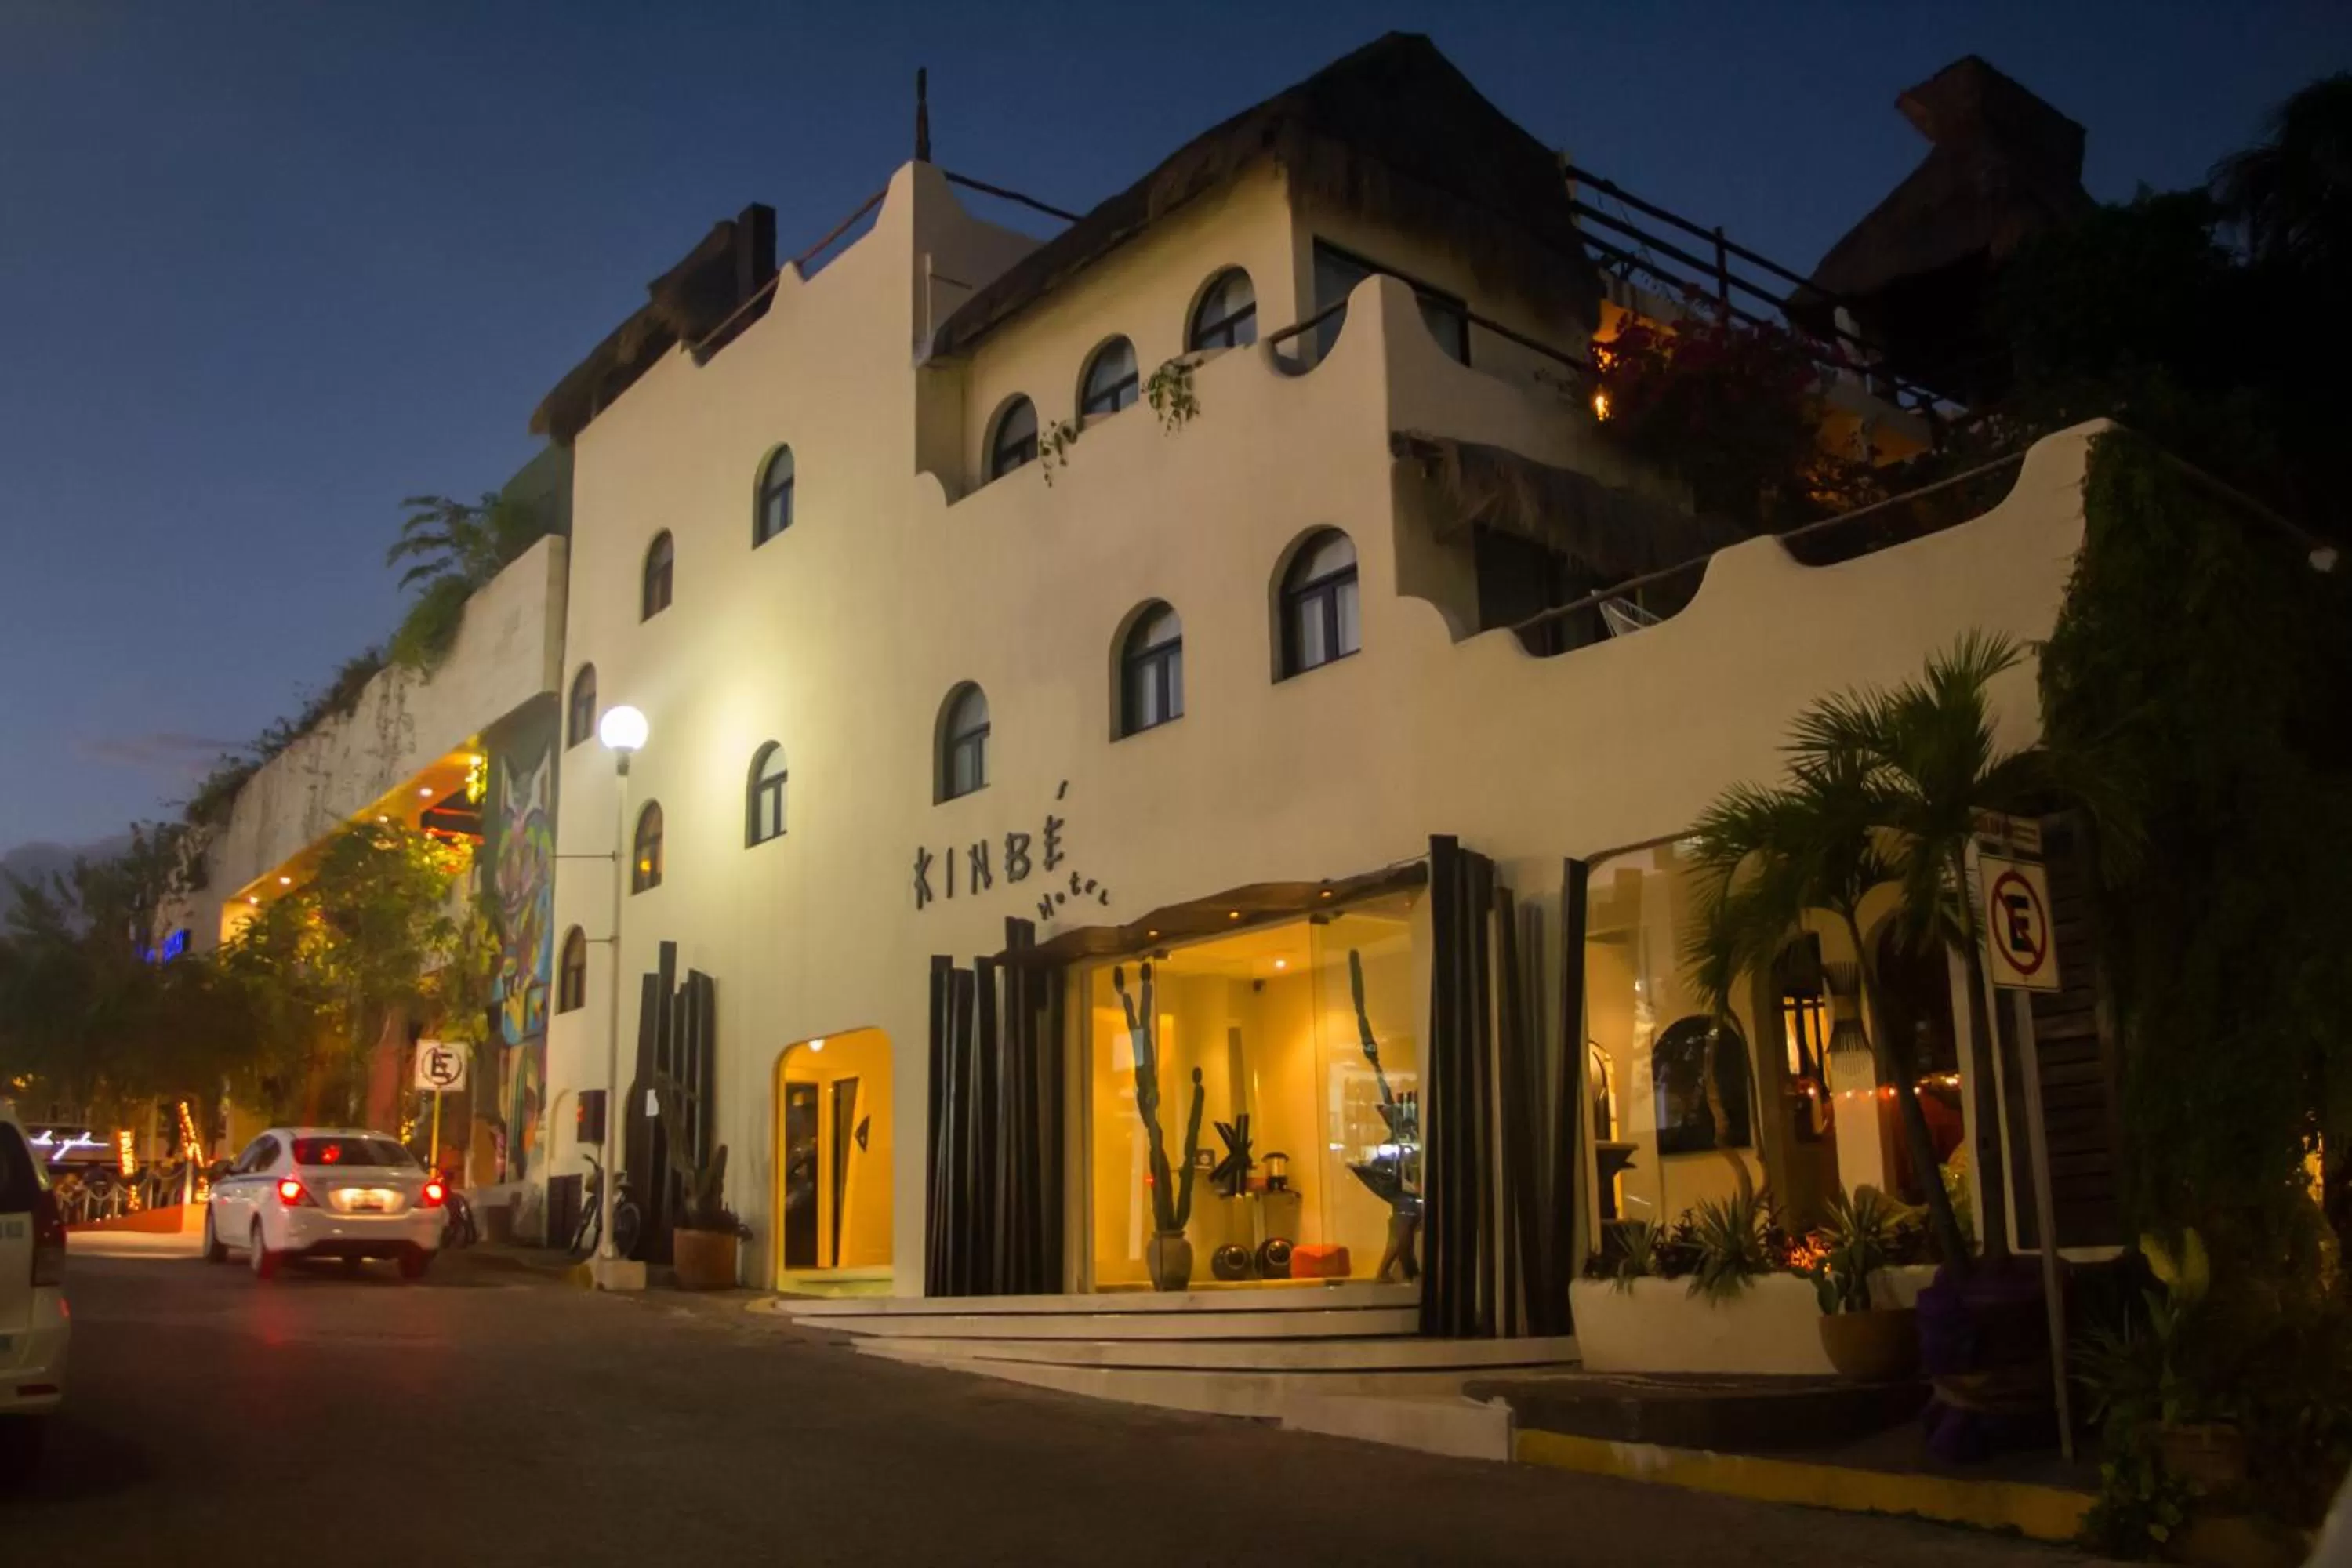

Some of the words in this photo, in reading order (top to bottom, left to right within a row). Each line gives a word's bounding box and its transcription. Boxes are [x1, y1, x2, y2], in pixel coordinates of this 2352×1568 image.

[913, 779, 1069, 910] KINBÉ
[2005, 895, 2034, 952] E
[431, 1052, 453, 1078] E
